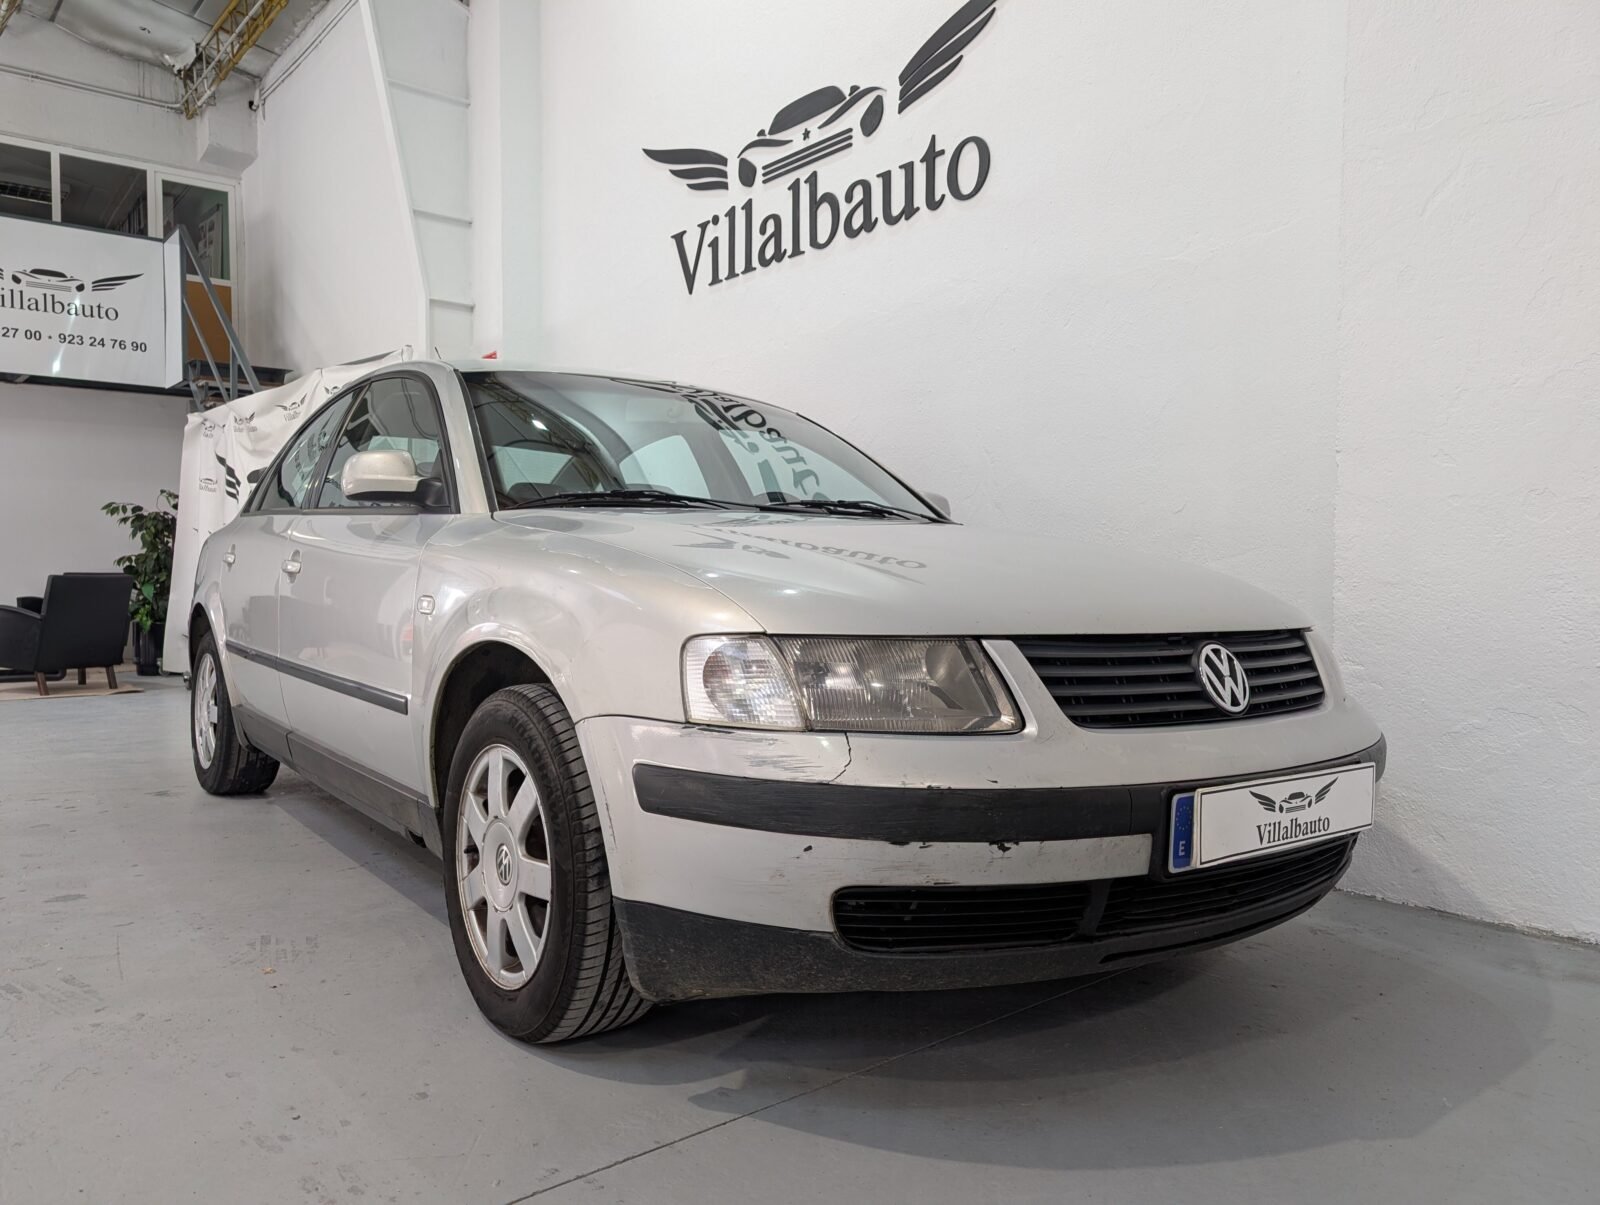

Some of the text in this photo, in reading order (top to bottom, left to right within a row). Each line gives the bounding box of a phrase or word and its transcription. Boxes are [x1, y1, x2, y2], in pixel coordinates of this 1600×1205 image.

[671, 133, 991, 295] Villalbauto
[0, 287, 119, 321] illalbauto
[1, 326, 147, 352] 27 00 923 24 76 90
[1255, 816, 1330, 846] Villalbauto
[1178, 840, 1186, 856] E
